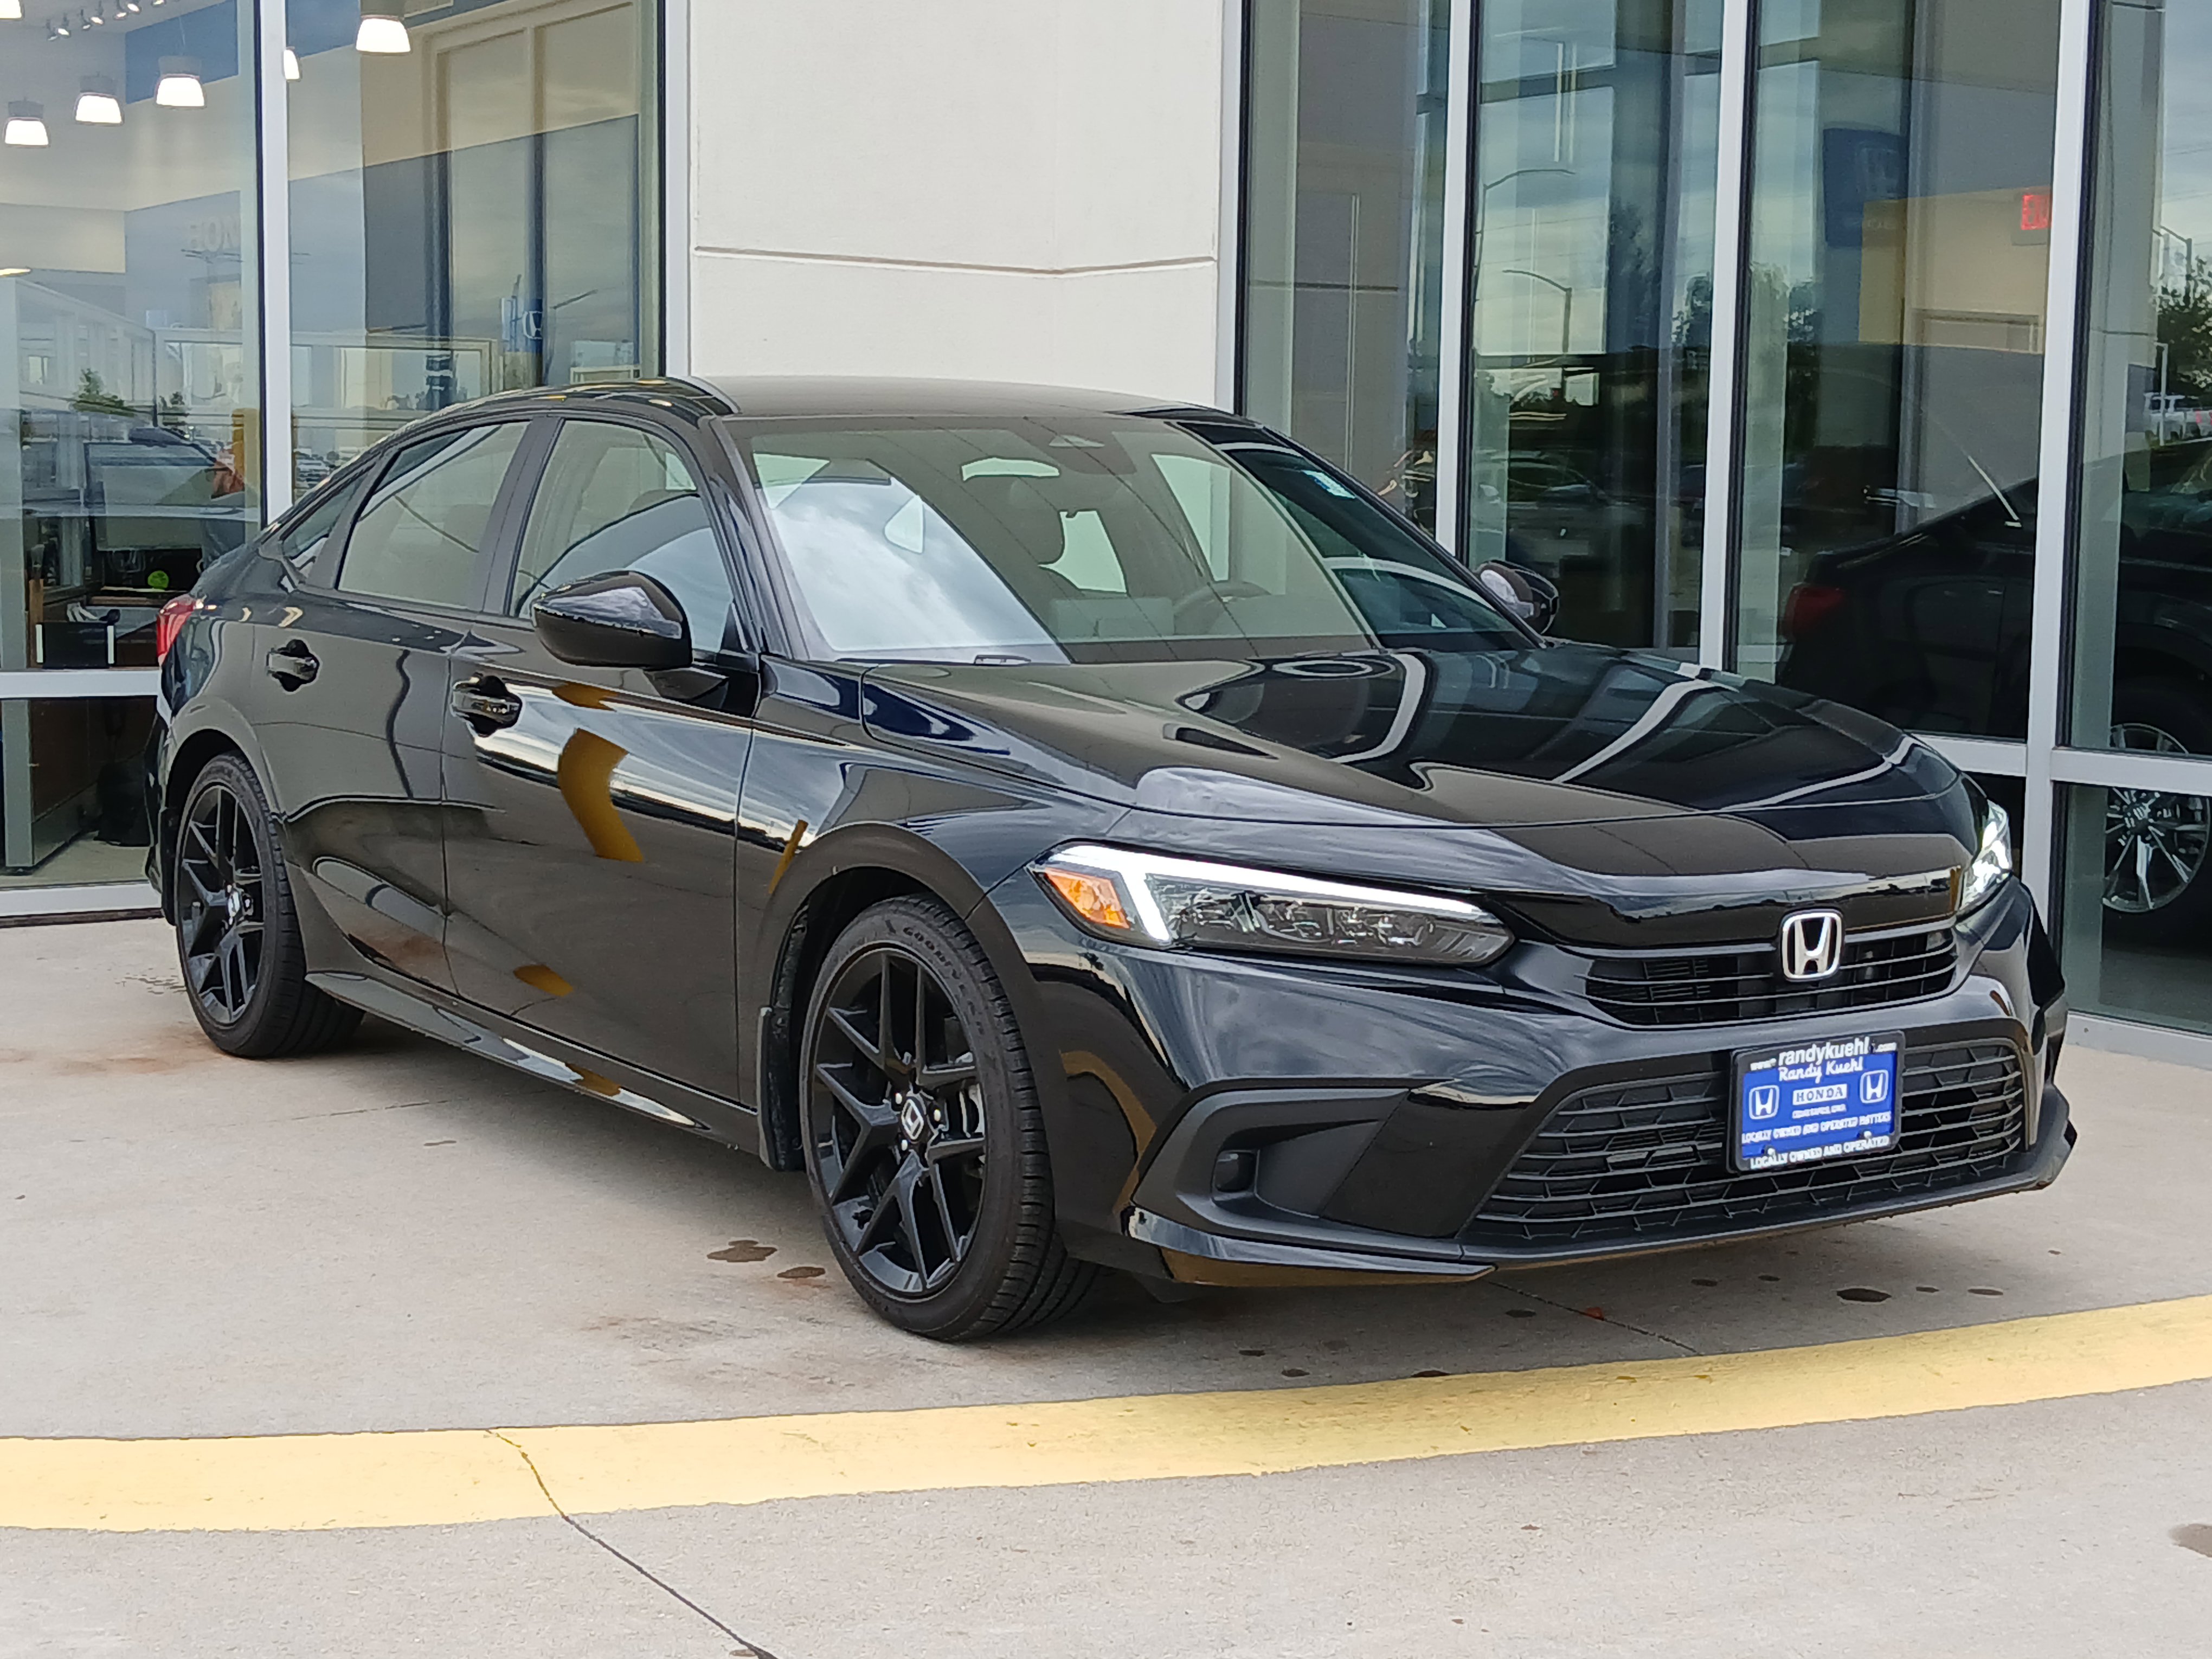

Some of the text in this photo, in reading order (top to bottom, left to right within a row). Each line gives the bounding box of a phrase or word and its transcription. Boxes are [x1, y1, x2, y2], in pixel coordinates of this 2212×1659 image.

[1778, 1063, 1822, 1084] Randy
[1825, 1056, 1863, 1076] Kuehl
[1796, 1086, 1844, 1103] HONDA
[1750, 1153, 1788, 1169] LOCALLY
[1823, 1143, 1842, 1157] AND
[1843, 1135, 1890, 1153] OPERATED
